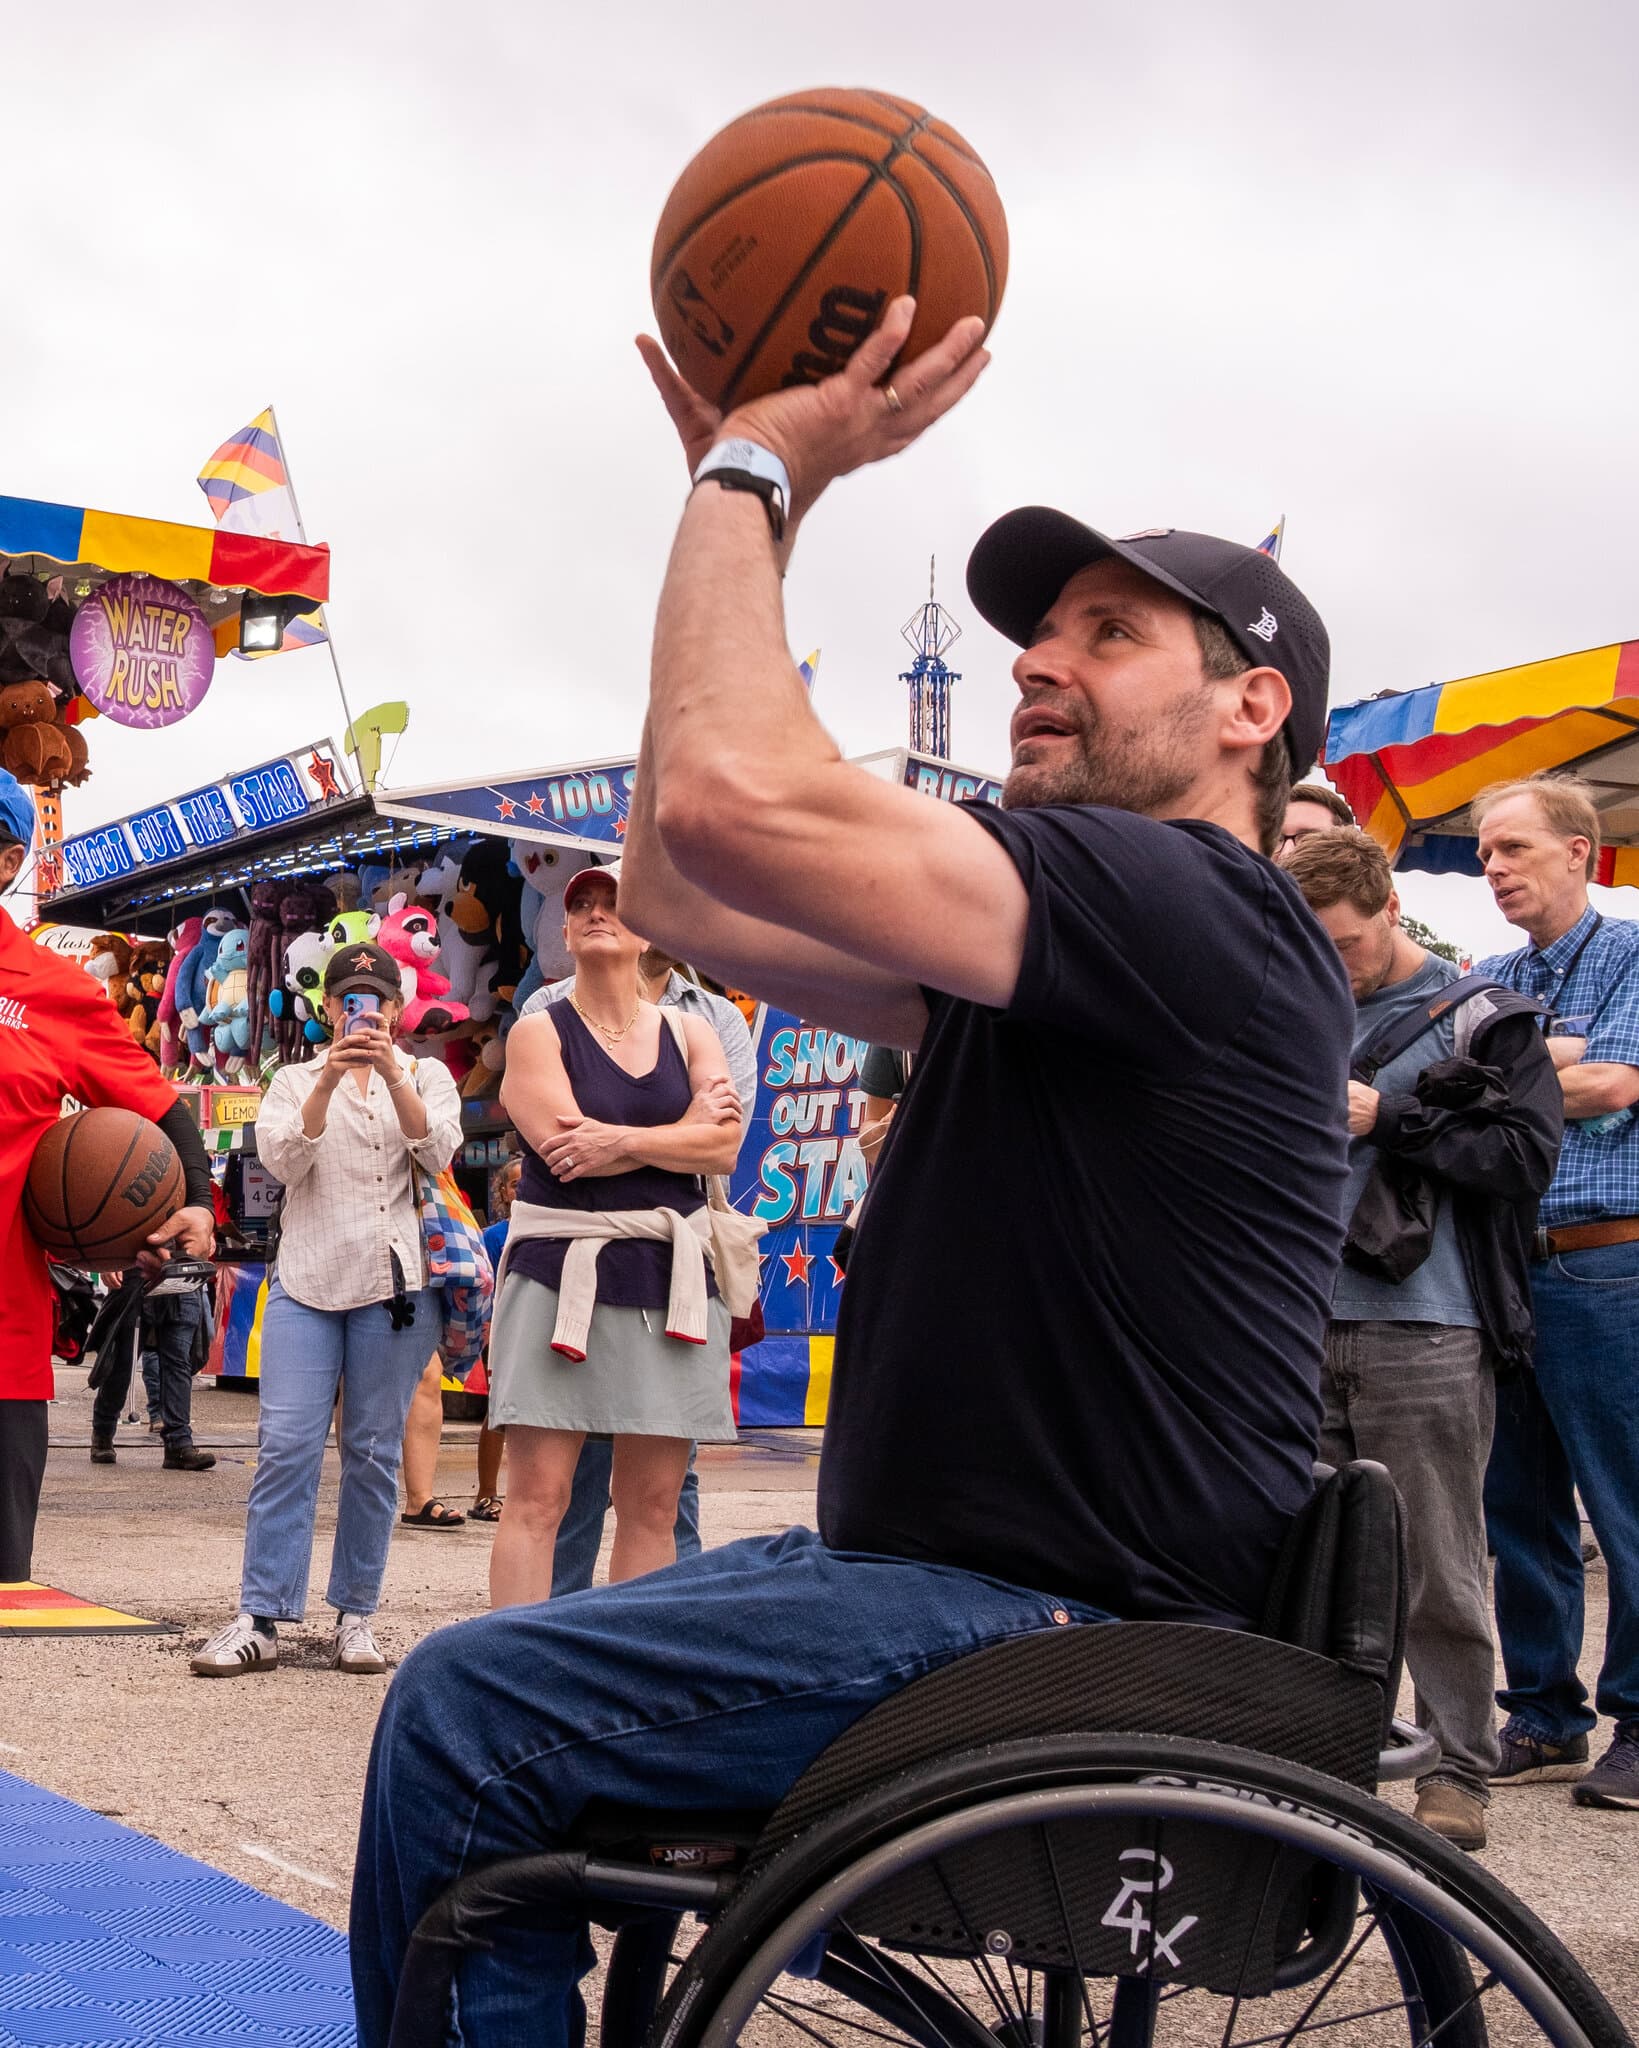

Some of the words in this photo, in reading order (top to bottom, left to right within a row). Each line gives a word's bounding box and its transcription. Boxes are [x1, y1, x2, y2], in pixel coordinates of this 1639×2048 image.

[100, 595, 192, 656] WATER
[105, 649, 184, 709] RUSH
[547, 774, 614, 821] 100
[63, 827, 130, 885] SHOOT
[129, 810, 181, 862] OUT
[178, 791, 233, 844] THE
[232, 764, 306, 827] STAR
[771, 1090, 841, 1137] OUT
[252, 1189, 261, 1203] 4
[664, 1848, 697, 1862] JAY
